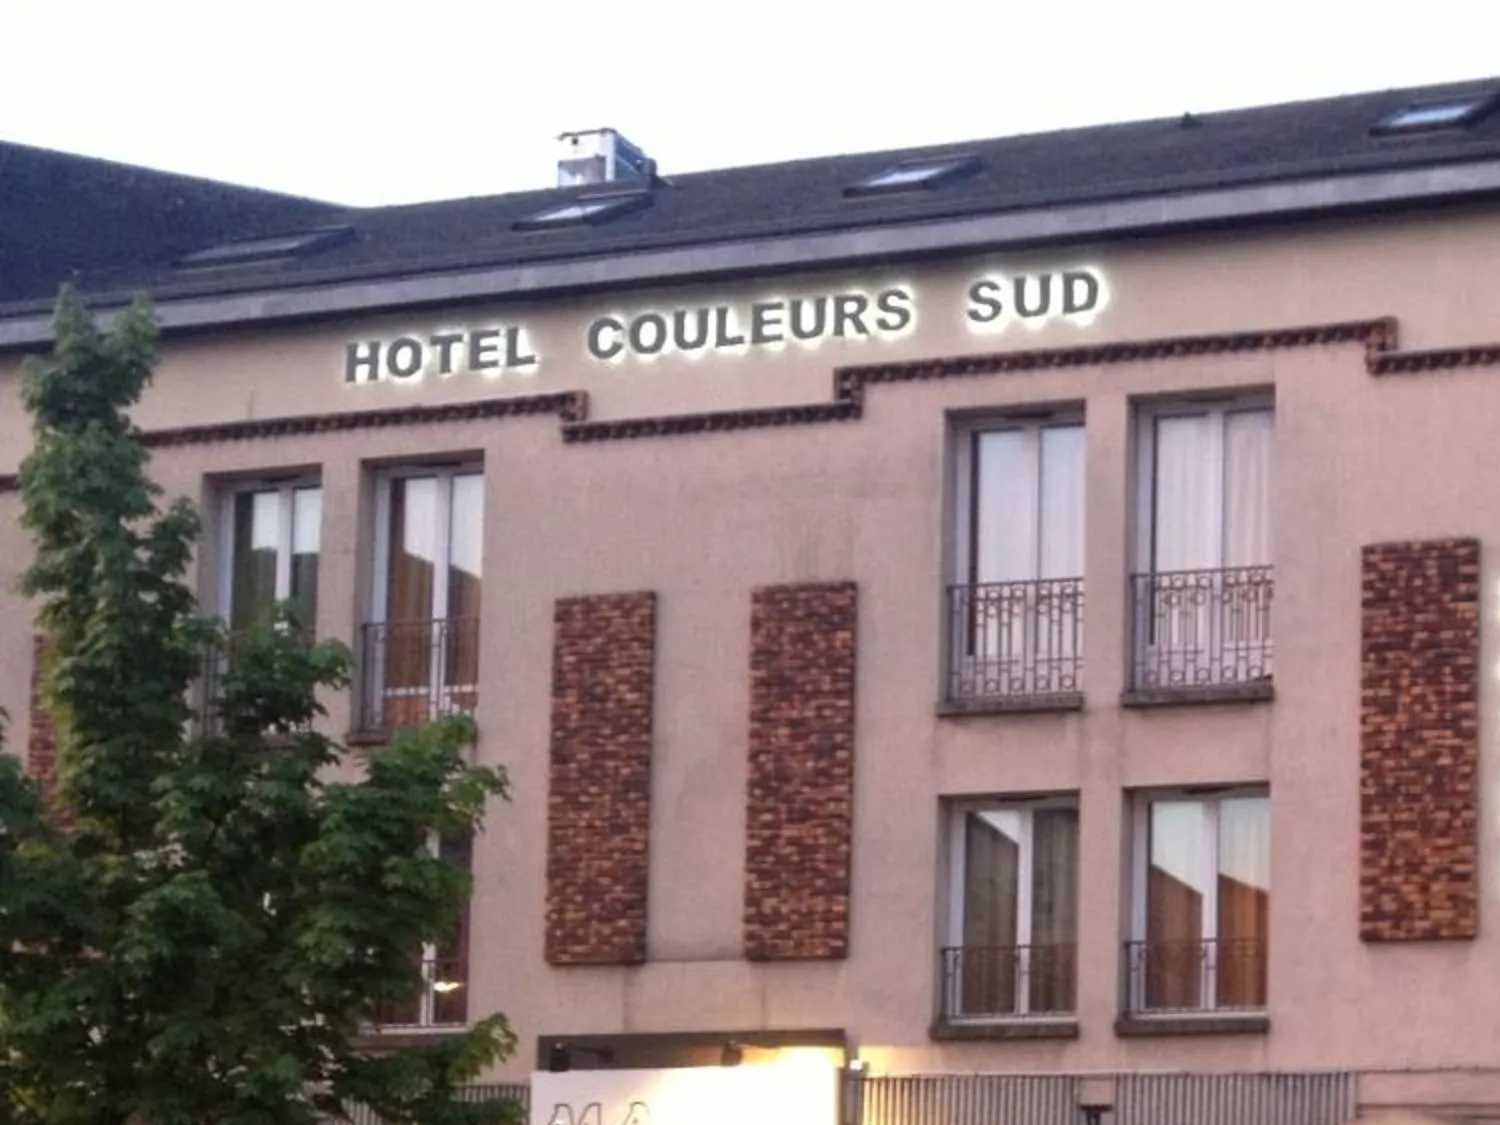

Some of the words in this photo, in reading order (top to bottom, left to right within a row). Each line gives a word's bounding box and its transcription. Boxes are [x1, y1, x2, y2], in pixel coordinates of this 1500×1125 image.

[345, 326, 537, 384] HOTEL
[587, 289, 912, 361] COULEURS
[966, 269, 1101, 323] SUD
